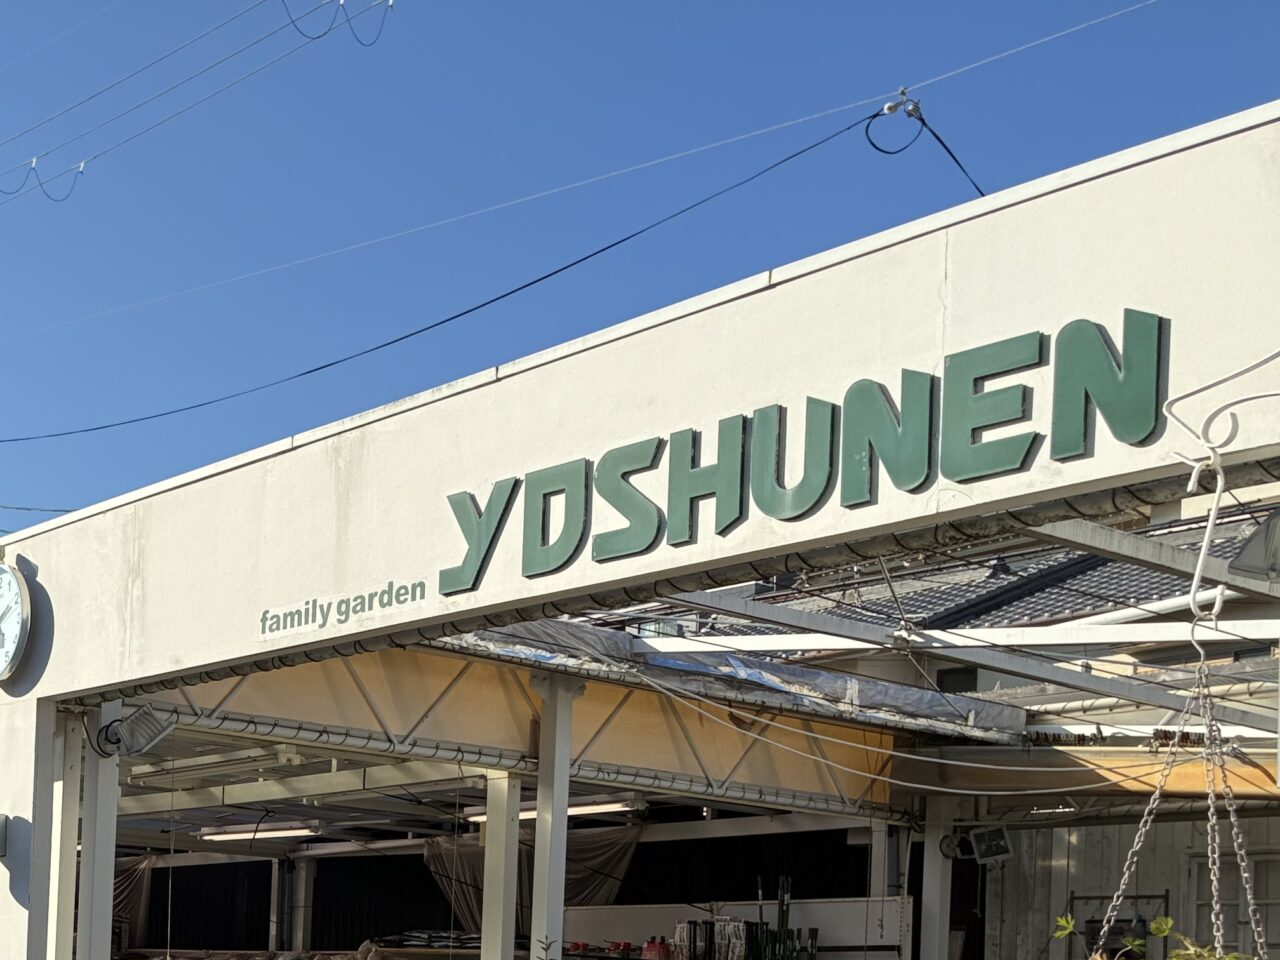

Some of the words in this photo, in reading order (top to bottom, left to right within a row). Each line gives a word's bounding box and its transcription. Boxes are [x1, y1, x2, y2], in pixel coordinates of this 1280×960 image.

[438, 308, 1168, 597] YOSHUNEN
[8, 580, 12, 592] 1
[15, 592, 20, 605] 2
[260, 598, 332, 634] family
[336, 580, 426, 624] garden
[5, 651, 10, 663] 5
